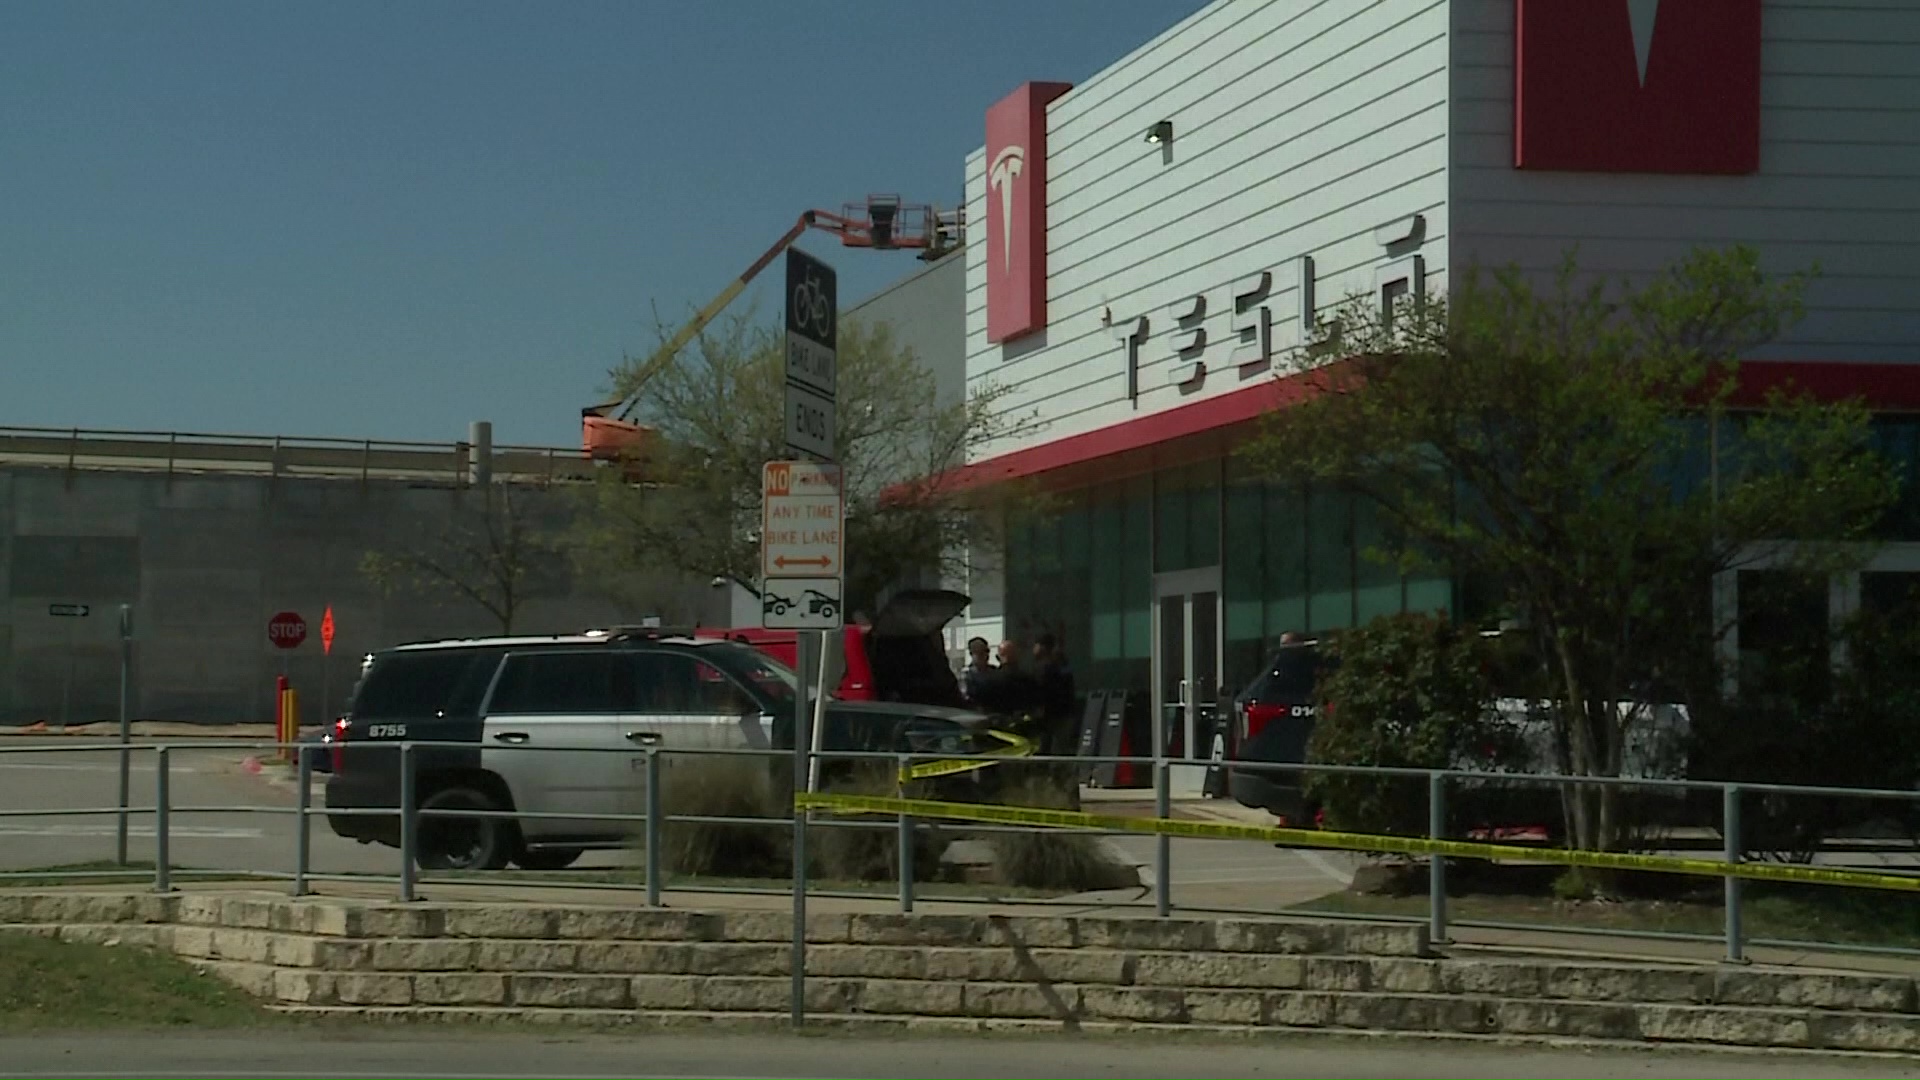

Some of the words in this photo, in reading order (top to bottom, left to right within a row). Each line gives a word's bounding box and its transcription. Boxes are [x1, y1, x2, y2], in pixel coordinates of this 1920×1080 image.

[1113, 214, 1425, 404] TESLA
[791, 341, 809, 372] BIKE
[796, 403, 825, 441] ENDS
[766, 469, 788, 490] NO
[773, 504, 800, 519] ANY
[806, 504, 834, 519] TIME
[767, 530, 797, 545] BIKE
[802, 530, 838, 545] LANE
[271, 623, 305, 638] STOP
[368, 724, 407, 738] 8755
